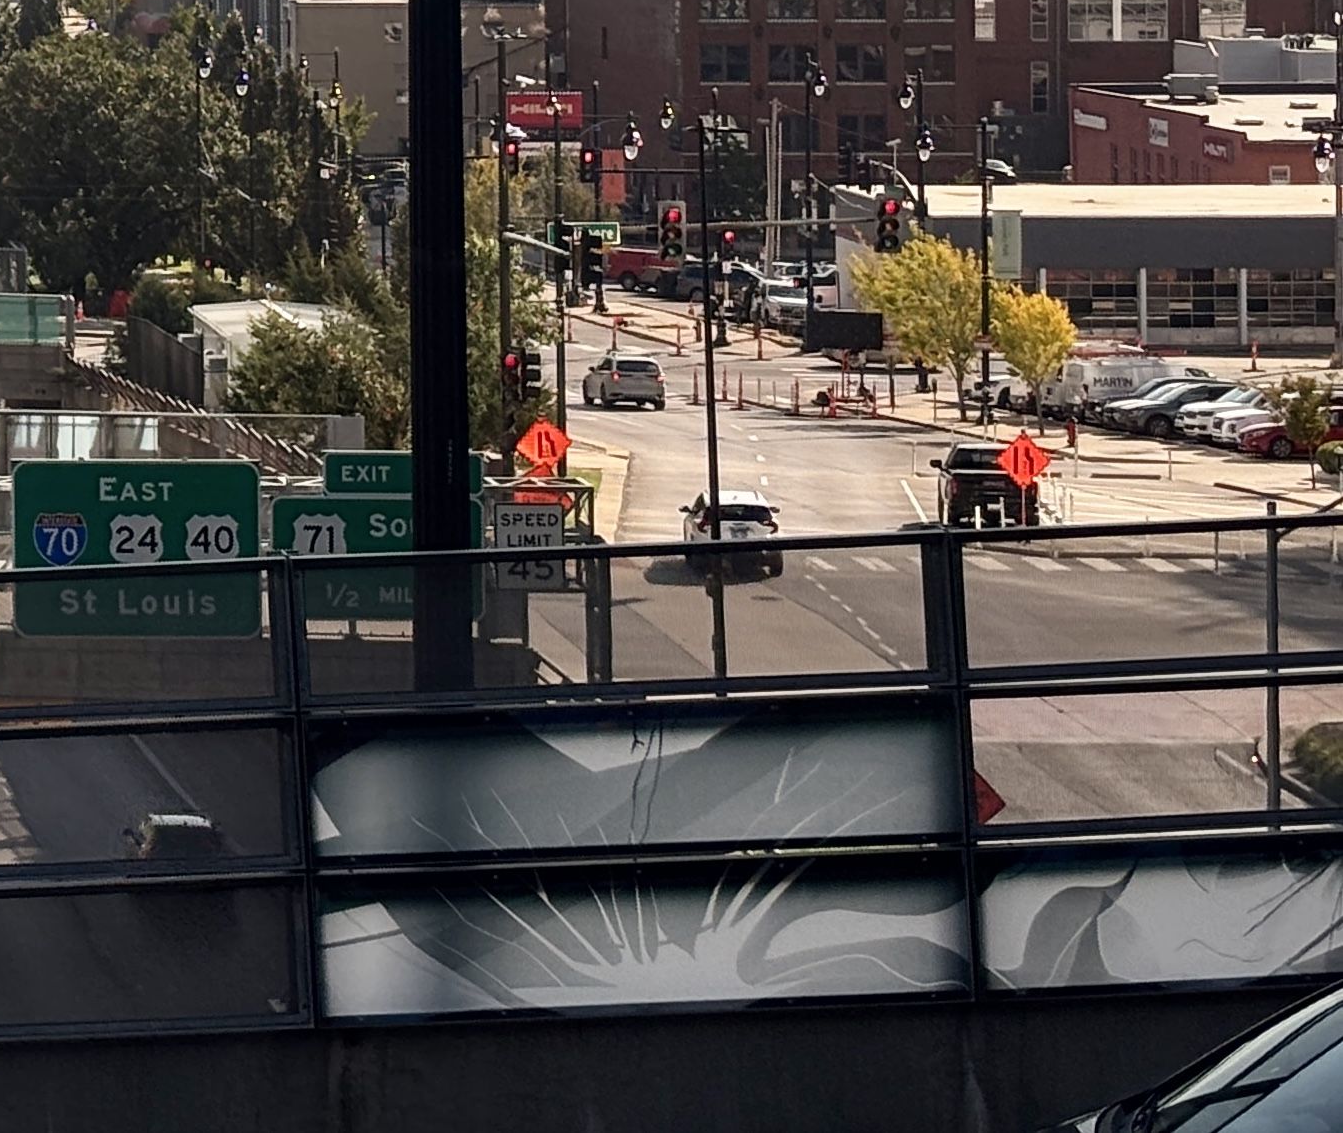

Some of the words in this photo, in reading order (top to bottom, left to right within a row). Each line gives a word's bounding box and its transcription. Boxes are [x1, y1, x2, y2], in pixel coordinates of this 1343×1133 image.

[1093, 377, 1133, 387] MARTIN
[341, 465, 391, 483] EXIT
[99, 476, 174, 502] EAST
[500, 513, 559, 527] SPEED
[43, 527, 79, 556] 70
[116, 525, 159, 554] 24
[190, 525, 235, 554] 40
[303, 524, 335, 553] 71
[507, 534, 552, 547] LIMIT
[507, 559, 554, 580] 45
[60, 589, 97, 615] St
[118, 589, 216, 615] Louis
